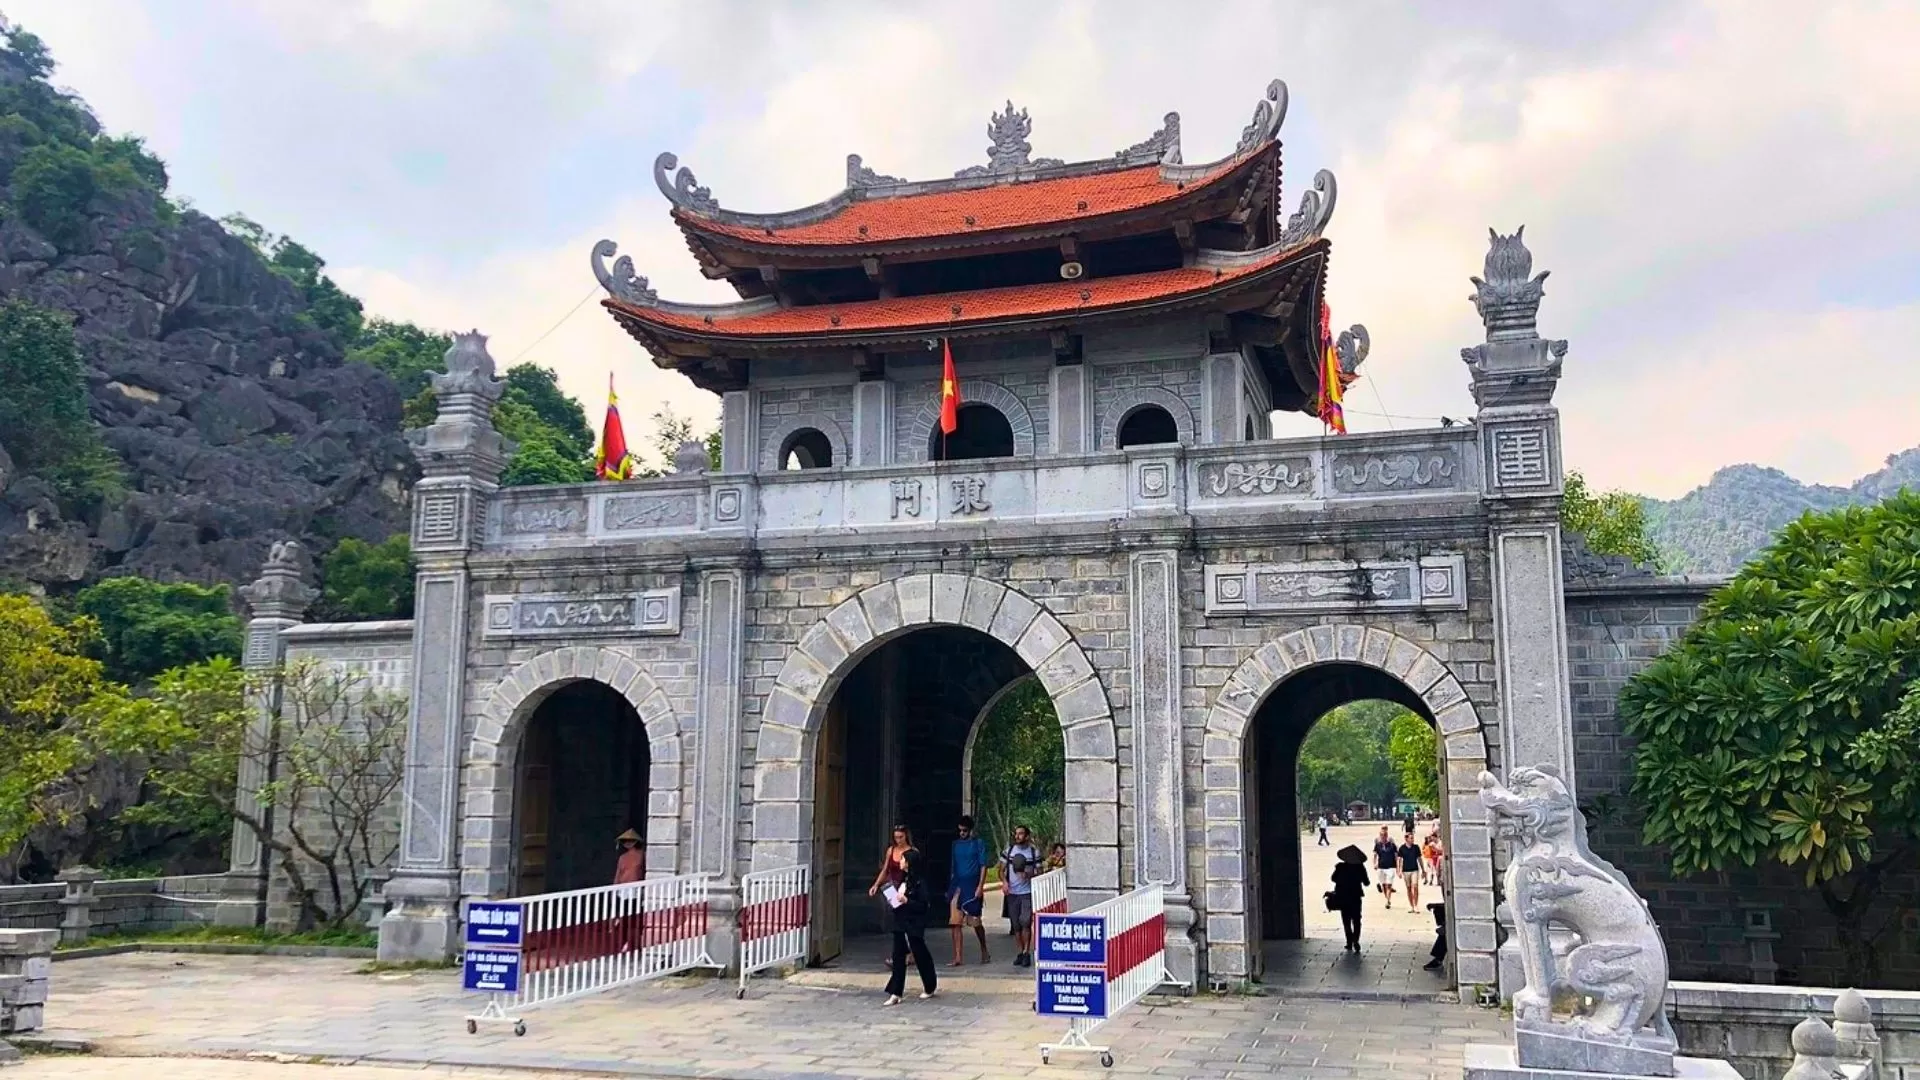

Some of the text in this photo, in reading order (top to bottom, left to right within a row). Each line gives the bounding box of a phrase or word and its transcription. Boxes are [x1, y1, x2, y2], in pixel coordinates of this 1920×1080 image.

[1051, 941, 1091, 952] Check Ticket
[482, 973, 500, 982] Exit
[1058, 994, 1085, 1004] Entrance
